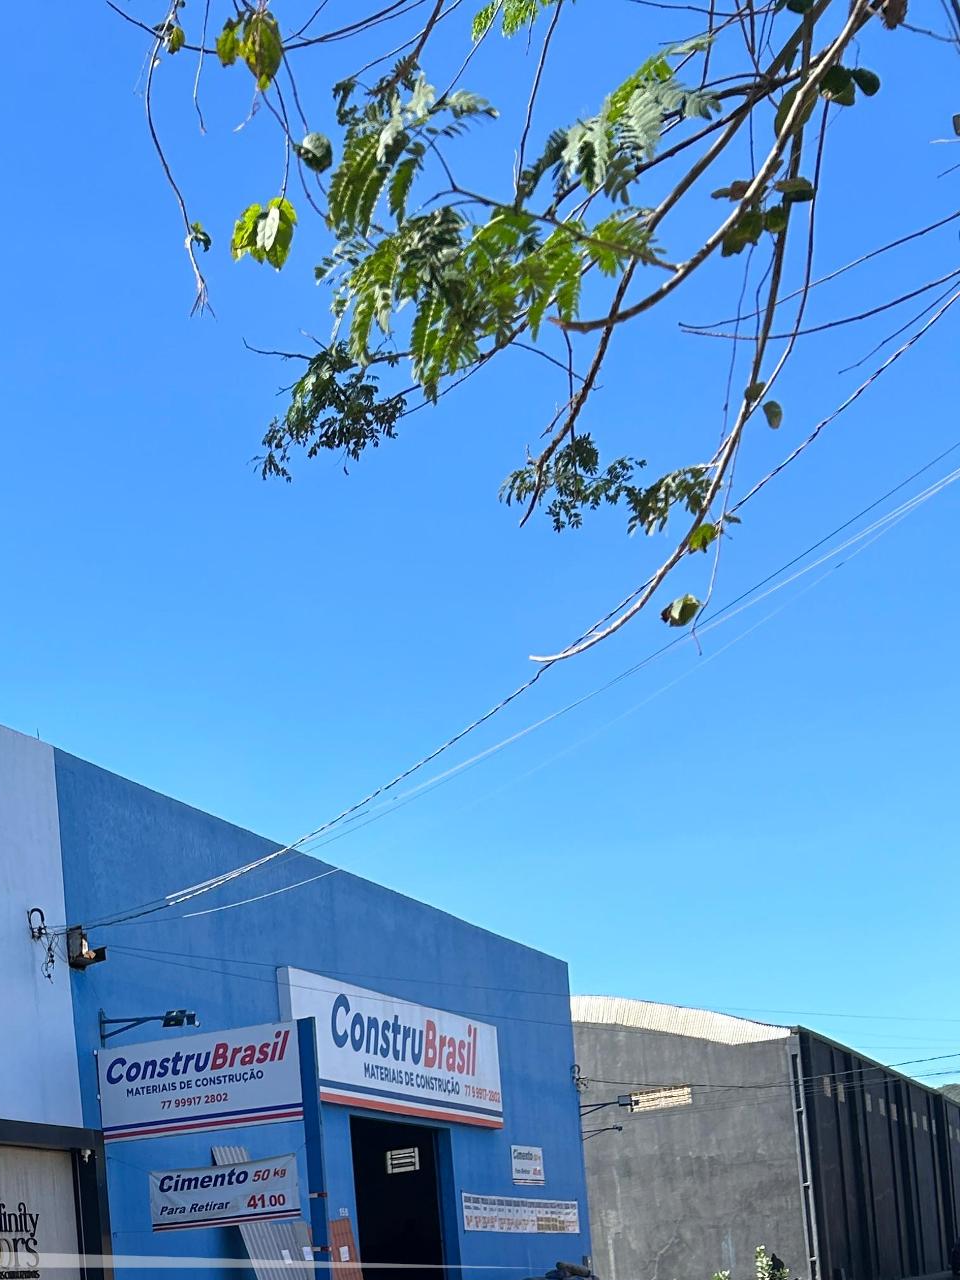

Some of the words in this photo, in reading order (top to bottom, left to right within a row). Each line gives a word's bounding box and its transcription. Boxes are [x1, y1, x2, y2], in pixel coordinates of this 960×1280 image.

[330, 993, 479, 1077] ConstruBrasil
[106, 1029, 290, 1085] ConstruBrasil
[126, 1081, 177, 1097] MATERIAIS
[179, 1079, 193, 1090] DE
[194, 1069, 264, 1088] CONSTRUÇÃO
[363, 1062, 404, 1086] MATERIAIS
[404, 1071, 415, 1087] DE
[415, 1073, 460, 1096] CONSTRUÇÃO
[464, 1084, 471, 1097] 77
[160, 1100, 172, 1110] 77
[174, 1096, 202, 1108] 99917
[204, 1092, 229, 1104] 2802
[159, 1167, 249, 1193] Cimento
[252, 1168, 270, 1182] 50
[273, 1167, 286, 1179] kg
[160, 1205, 186, 1216] Para
[189, 1200, 230, 1213] Retirar
